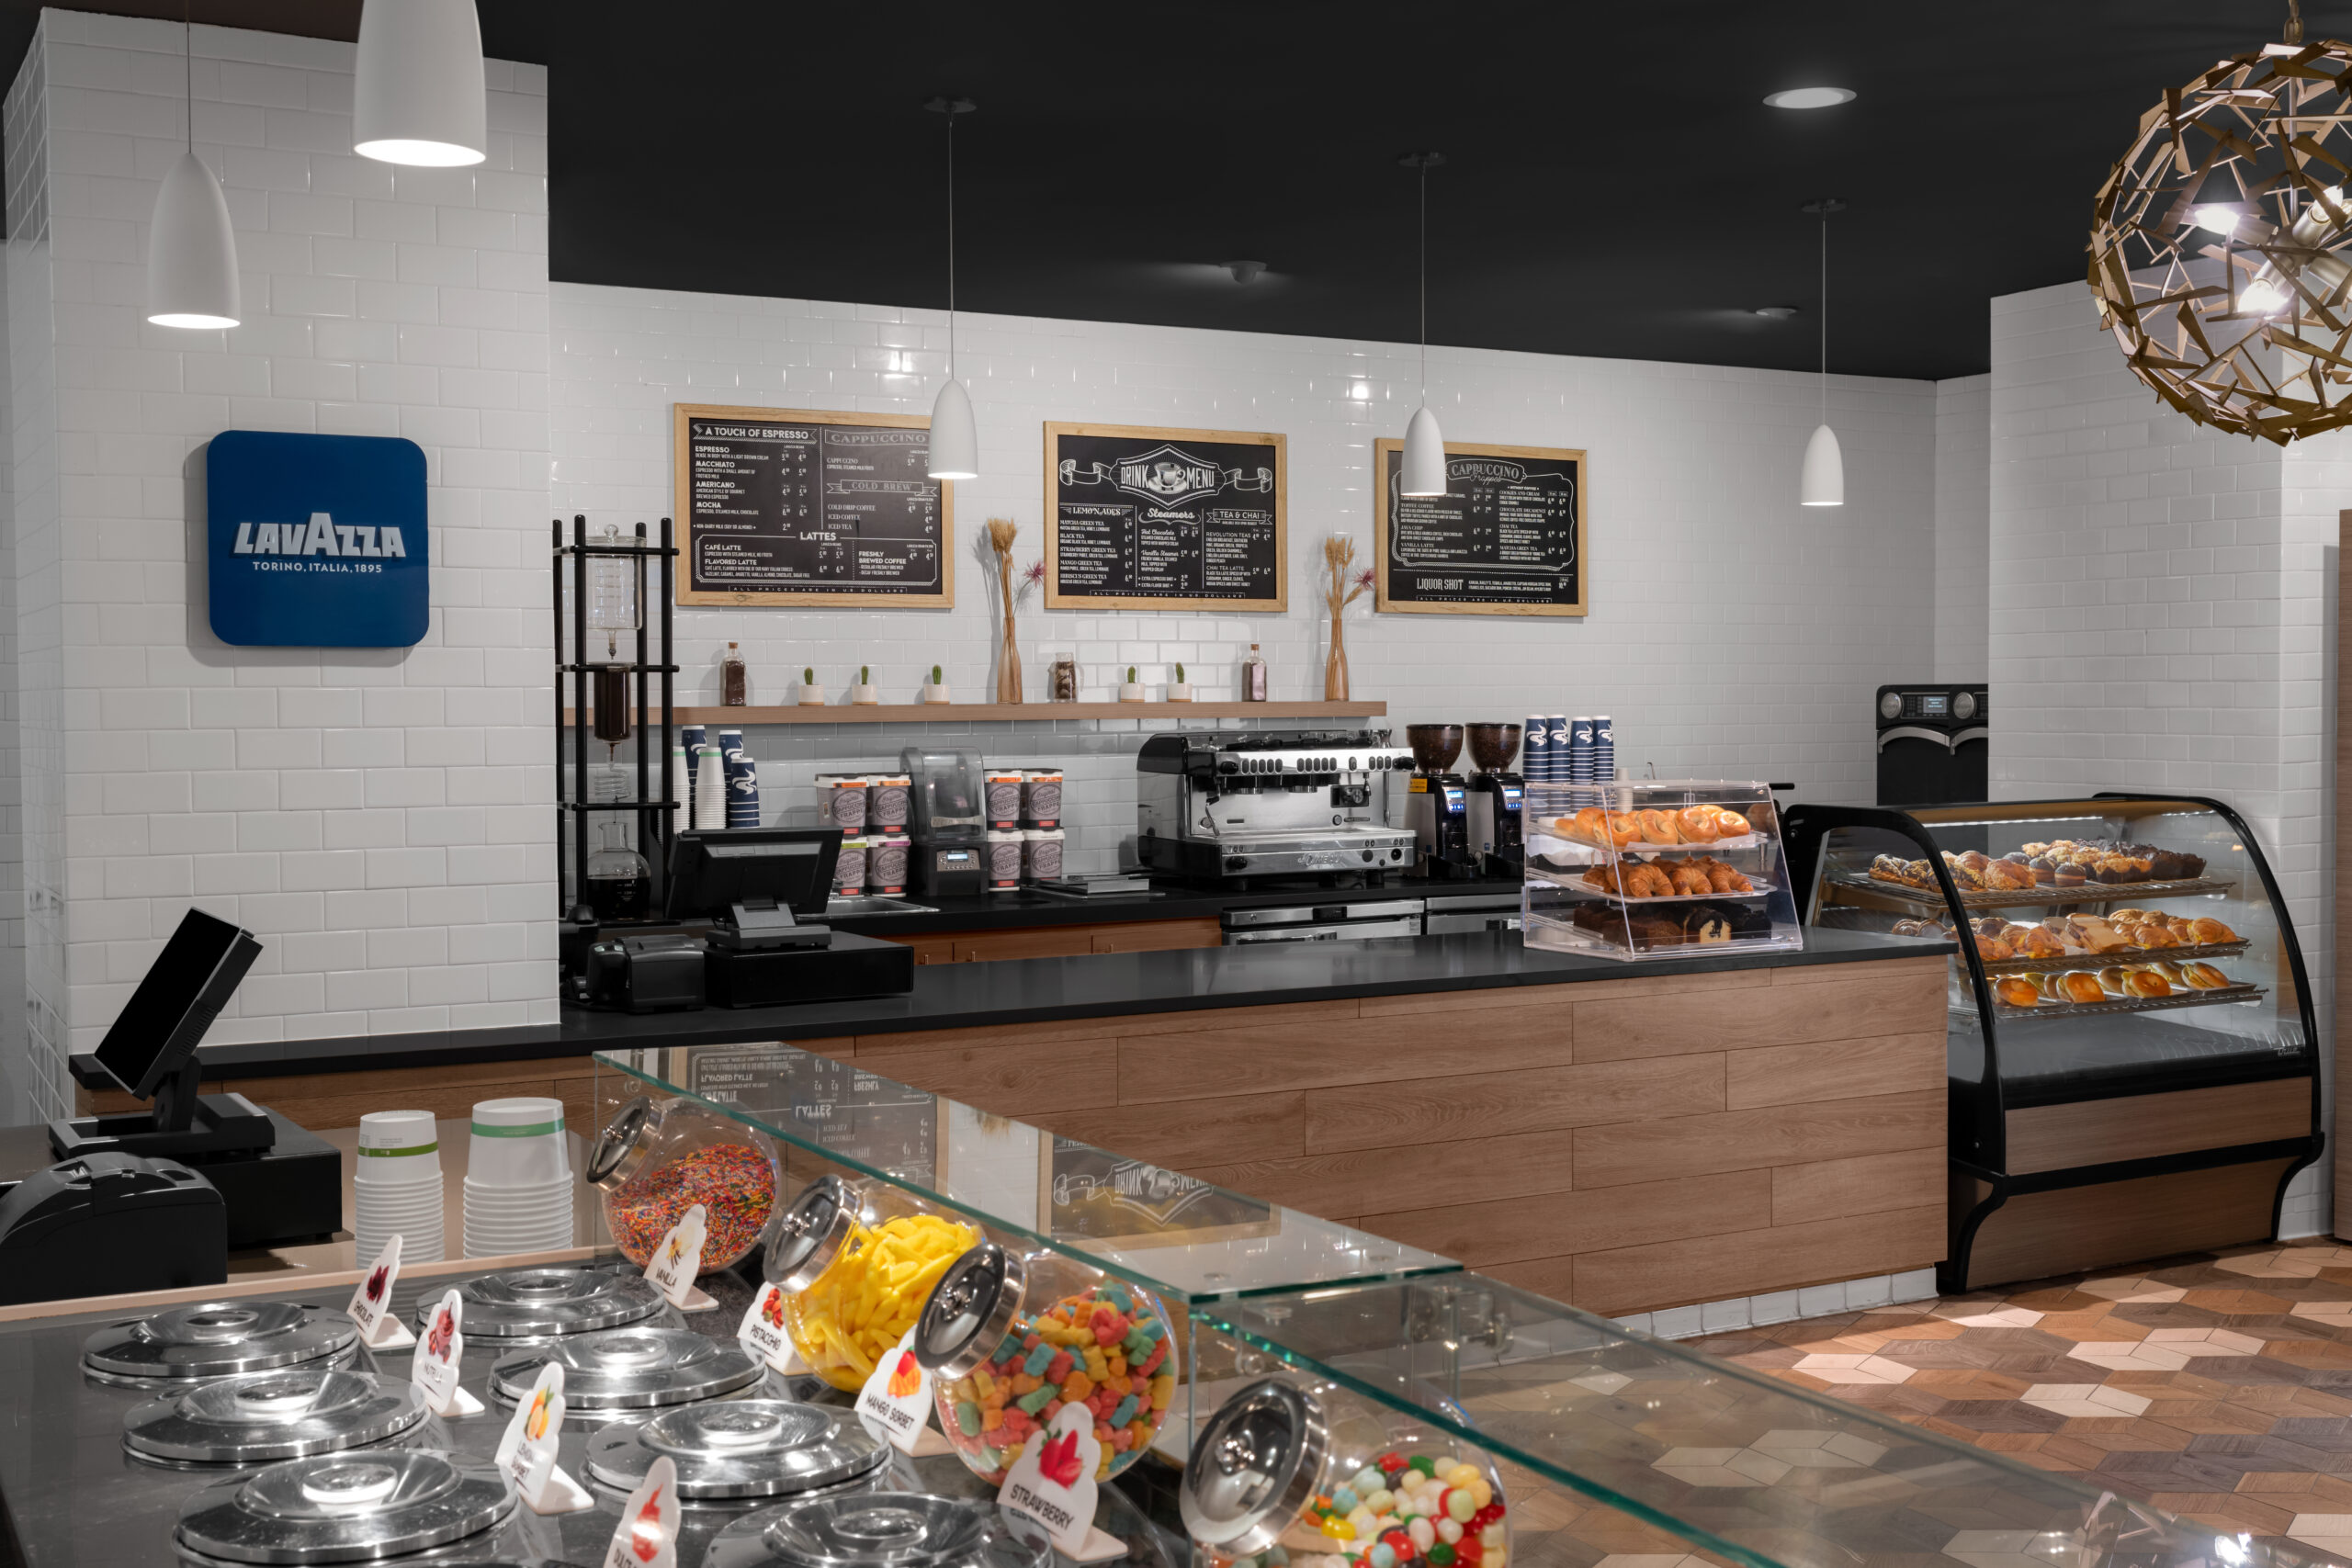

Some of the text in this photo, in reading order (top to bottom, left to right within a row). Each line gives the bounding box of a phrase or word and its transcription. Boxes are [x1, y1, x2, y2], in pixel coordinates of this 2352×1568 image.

[706, 427, 808, 439] A TOUCH OF ESPRESSO
[831, 434, 926, 443] CAPPUCCINO
[1121, 465, 1214, 490] DRINK MENU
[1452, 464, 1519, 479] CAPPUCCINO
[884, 482, 911, 491] BREW
[1073, 507, 1120, 515] LEMONADES
[1148, 508, 1195, 518] Steamers
[233, 513, 406, 558] LAVAZZA
[800, 532, 836, 540] LATTES
[355, 564, 382, 573] 1895
[1417, 578, 1442, 591] LIQUOR
[1444, 579, 1464, 590] SHOT
[750, 1324, 781, 1351] PISTACCHIO
[865, 1393, 915, 1431] MANGO SORBET
[1010, 1483, 1075, 1530] STRAWBERRY
